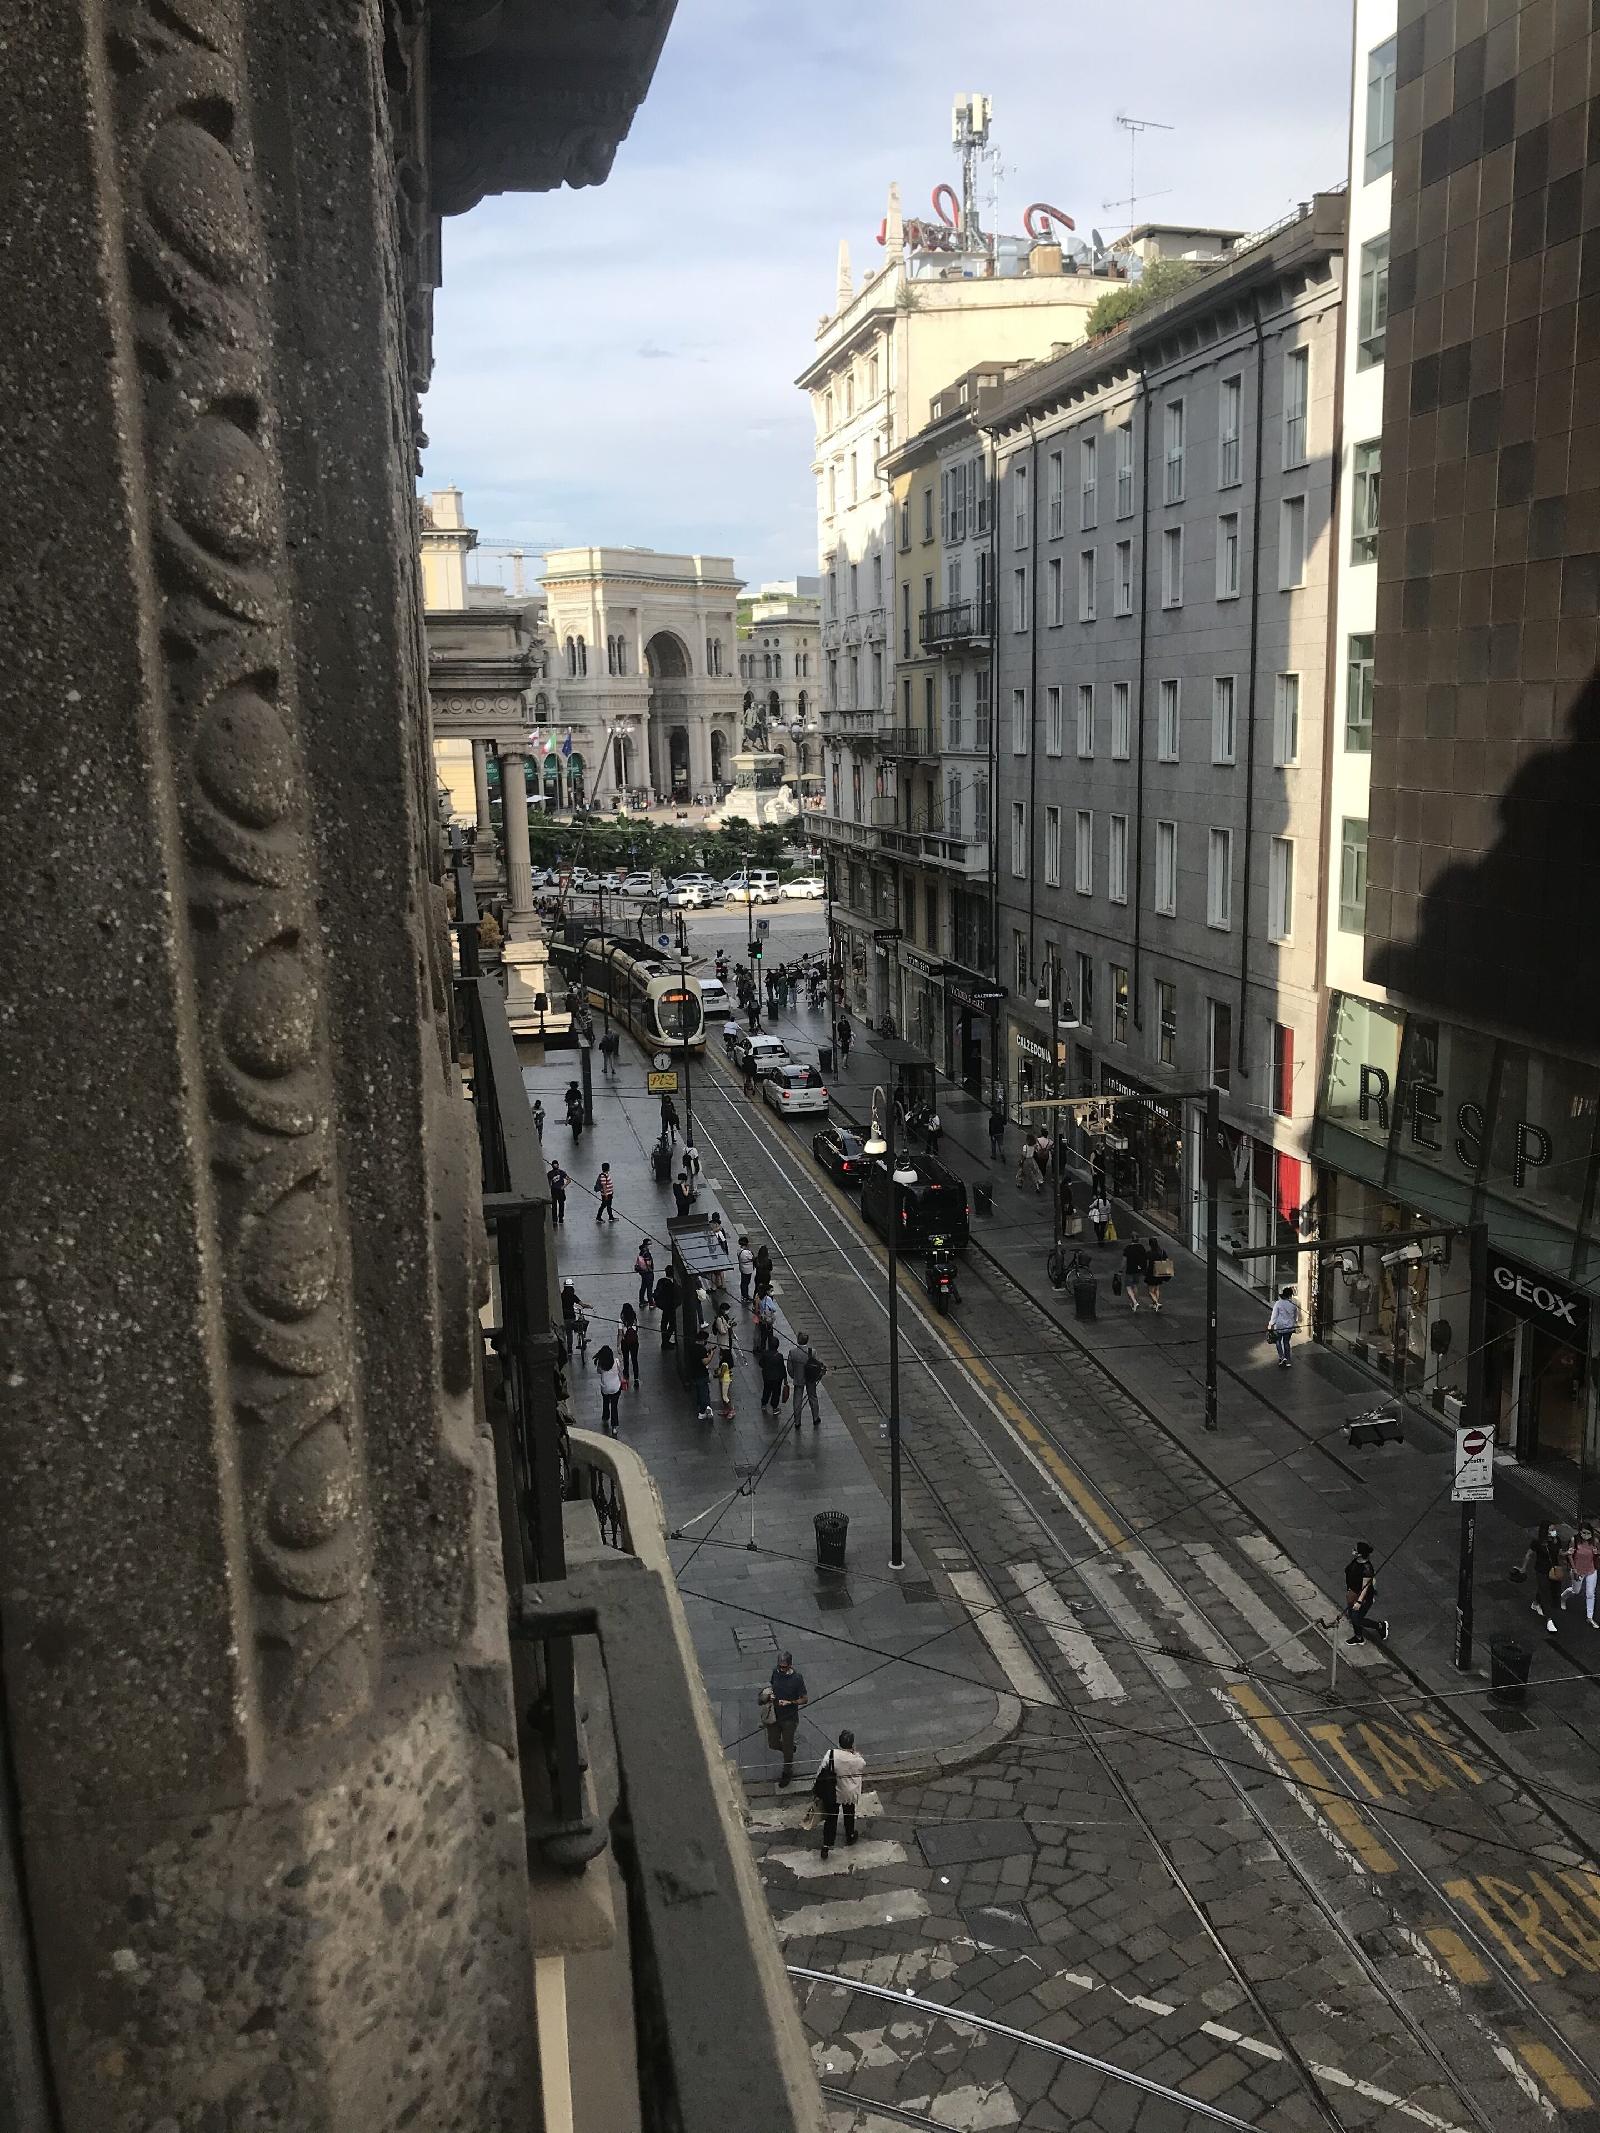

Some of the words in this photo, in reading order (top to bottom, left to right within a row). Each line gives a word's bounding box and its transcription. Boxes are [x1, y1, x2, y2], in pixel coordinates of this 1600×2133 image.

[1016, 1034, 1052, 1064] CALZEDONIA
[1360, 1063, 1552, 1188] RESP
[1493, 1266, 1577, 1327] GEOX
[1307, 1713, 1483, 1799] TAXI
